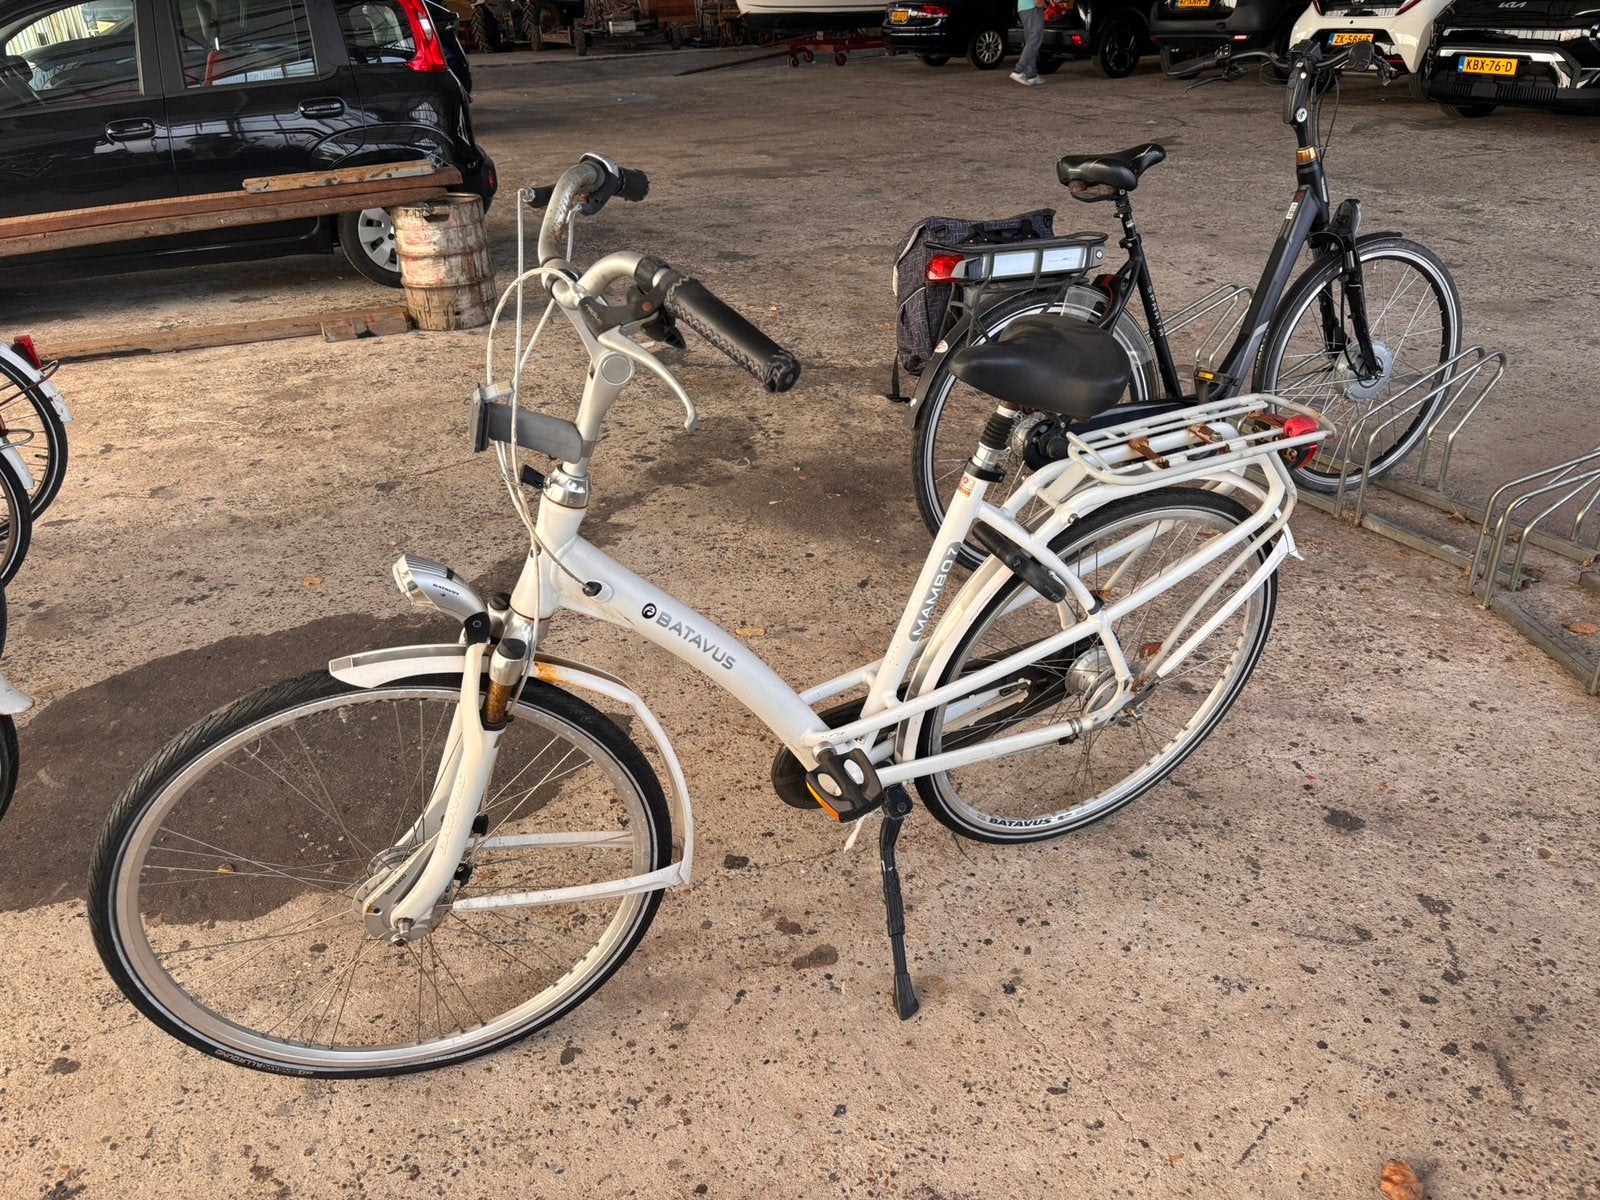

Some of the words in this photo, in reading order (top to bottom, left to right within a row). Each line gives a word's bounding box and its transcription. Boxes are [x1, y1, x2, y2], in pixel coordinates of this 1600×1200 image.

[1466, 59, 1512, 72] KBX-76-D
[912, 560, 953, 636] MAMBO
[655, 611, 736, 670] BATAVUS
[988, 817, 1052, 828] BATAVUS
[214, 1049, 263, 1068] ALLROUND
